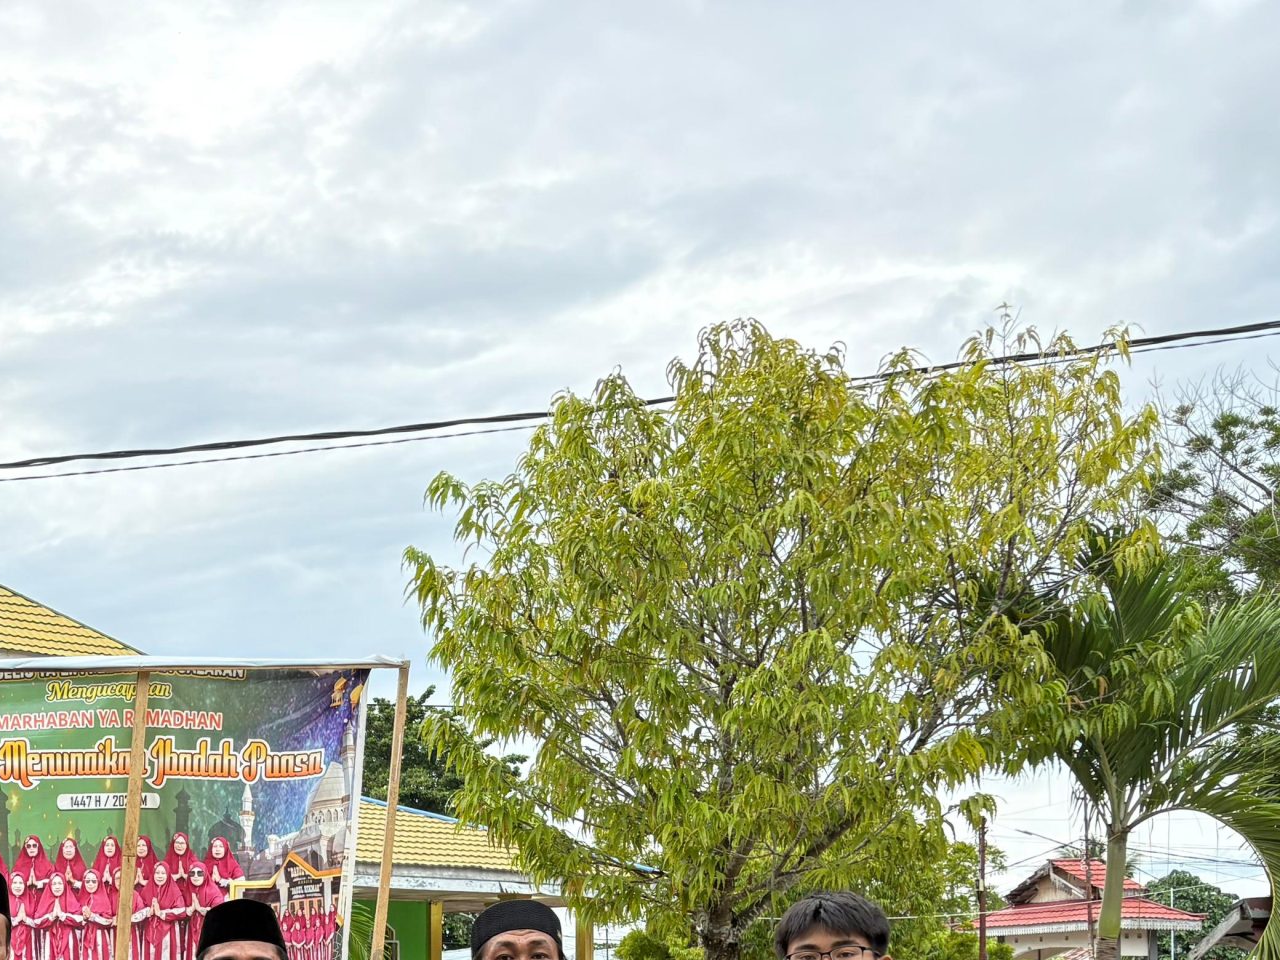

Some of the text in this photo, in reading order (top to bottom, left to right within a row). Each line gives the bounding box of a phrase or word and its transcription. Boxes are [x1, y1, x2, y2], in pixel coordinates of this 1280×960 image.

[47, 681, 171, 703] Mengucapan
[99, 709, 122, 729] YA
[123, 710, 222, 729] RMADHAN
[242, 737, 326, 782] Puasa
[71, 796, 91, 807] 1447
[95, 796, 100, 807] H
